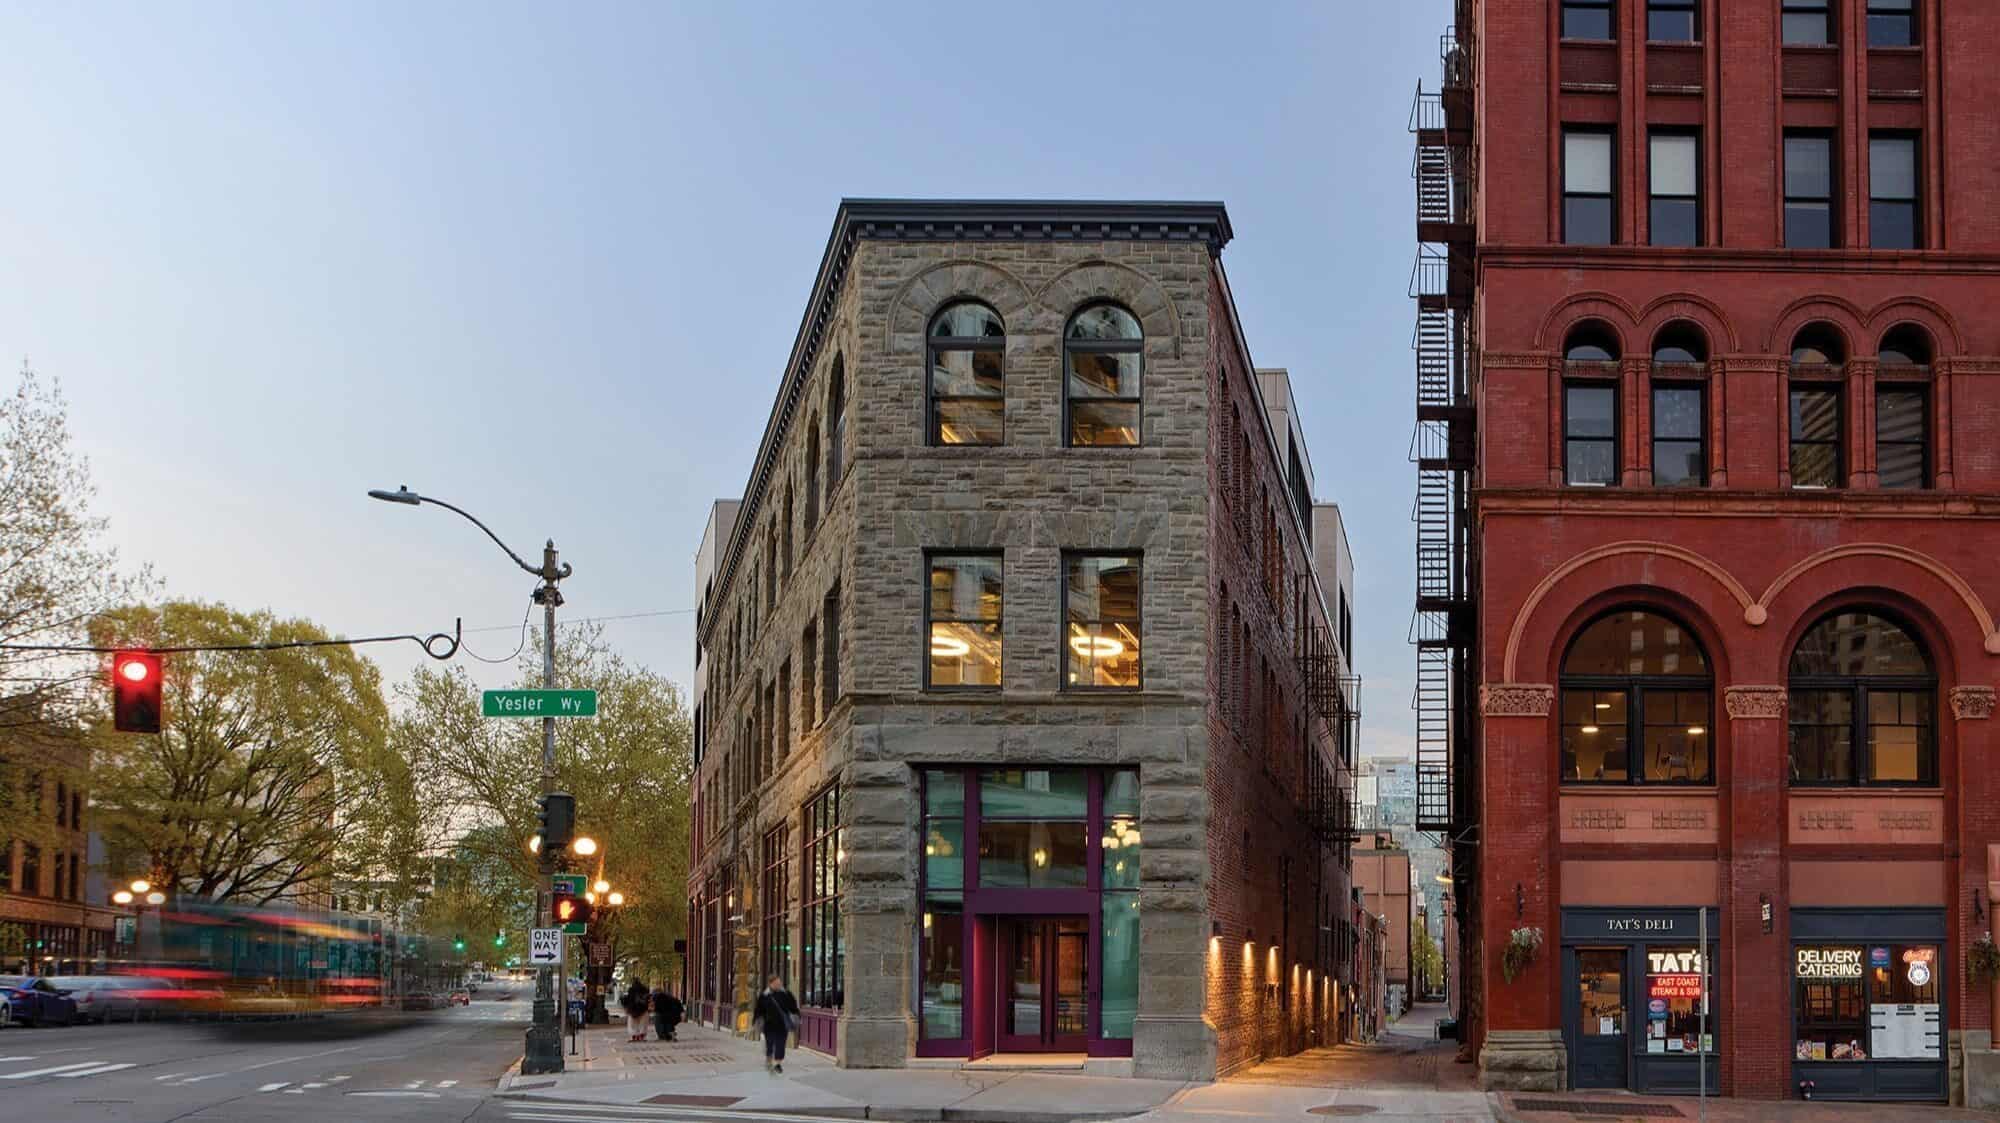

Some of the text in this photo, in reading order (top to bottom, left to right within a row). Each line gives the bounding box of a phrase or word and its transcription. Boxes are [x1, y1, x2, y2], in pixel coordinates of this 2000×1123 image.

[494, 695, 582, 713] Yesler Wy
[1607, 918, 1673, 930] TAT'S DELI
[534, 930, 559, 940] ONE
[533, 940, 559, 950] WAY
[1798, 950, 1862, 963] DELIVERY
[1798, 963, 1863, 976] CATERING
[1657, 977, 1699, 986] EAST COAST
